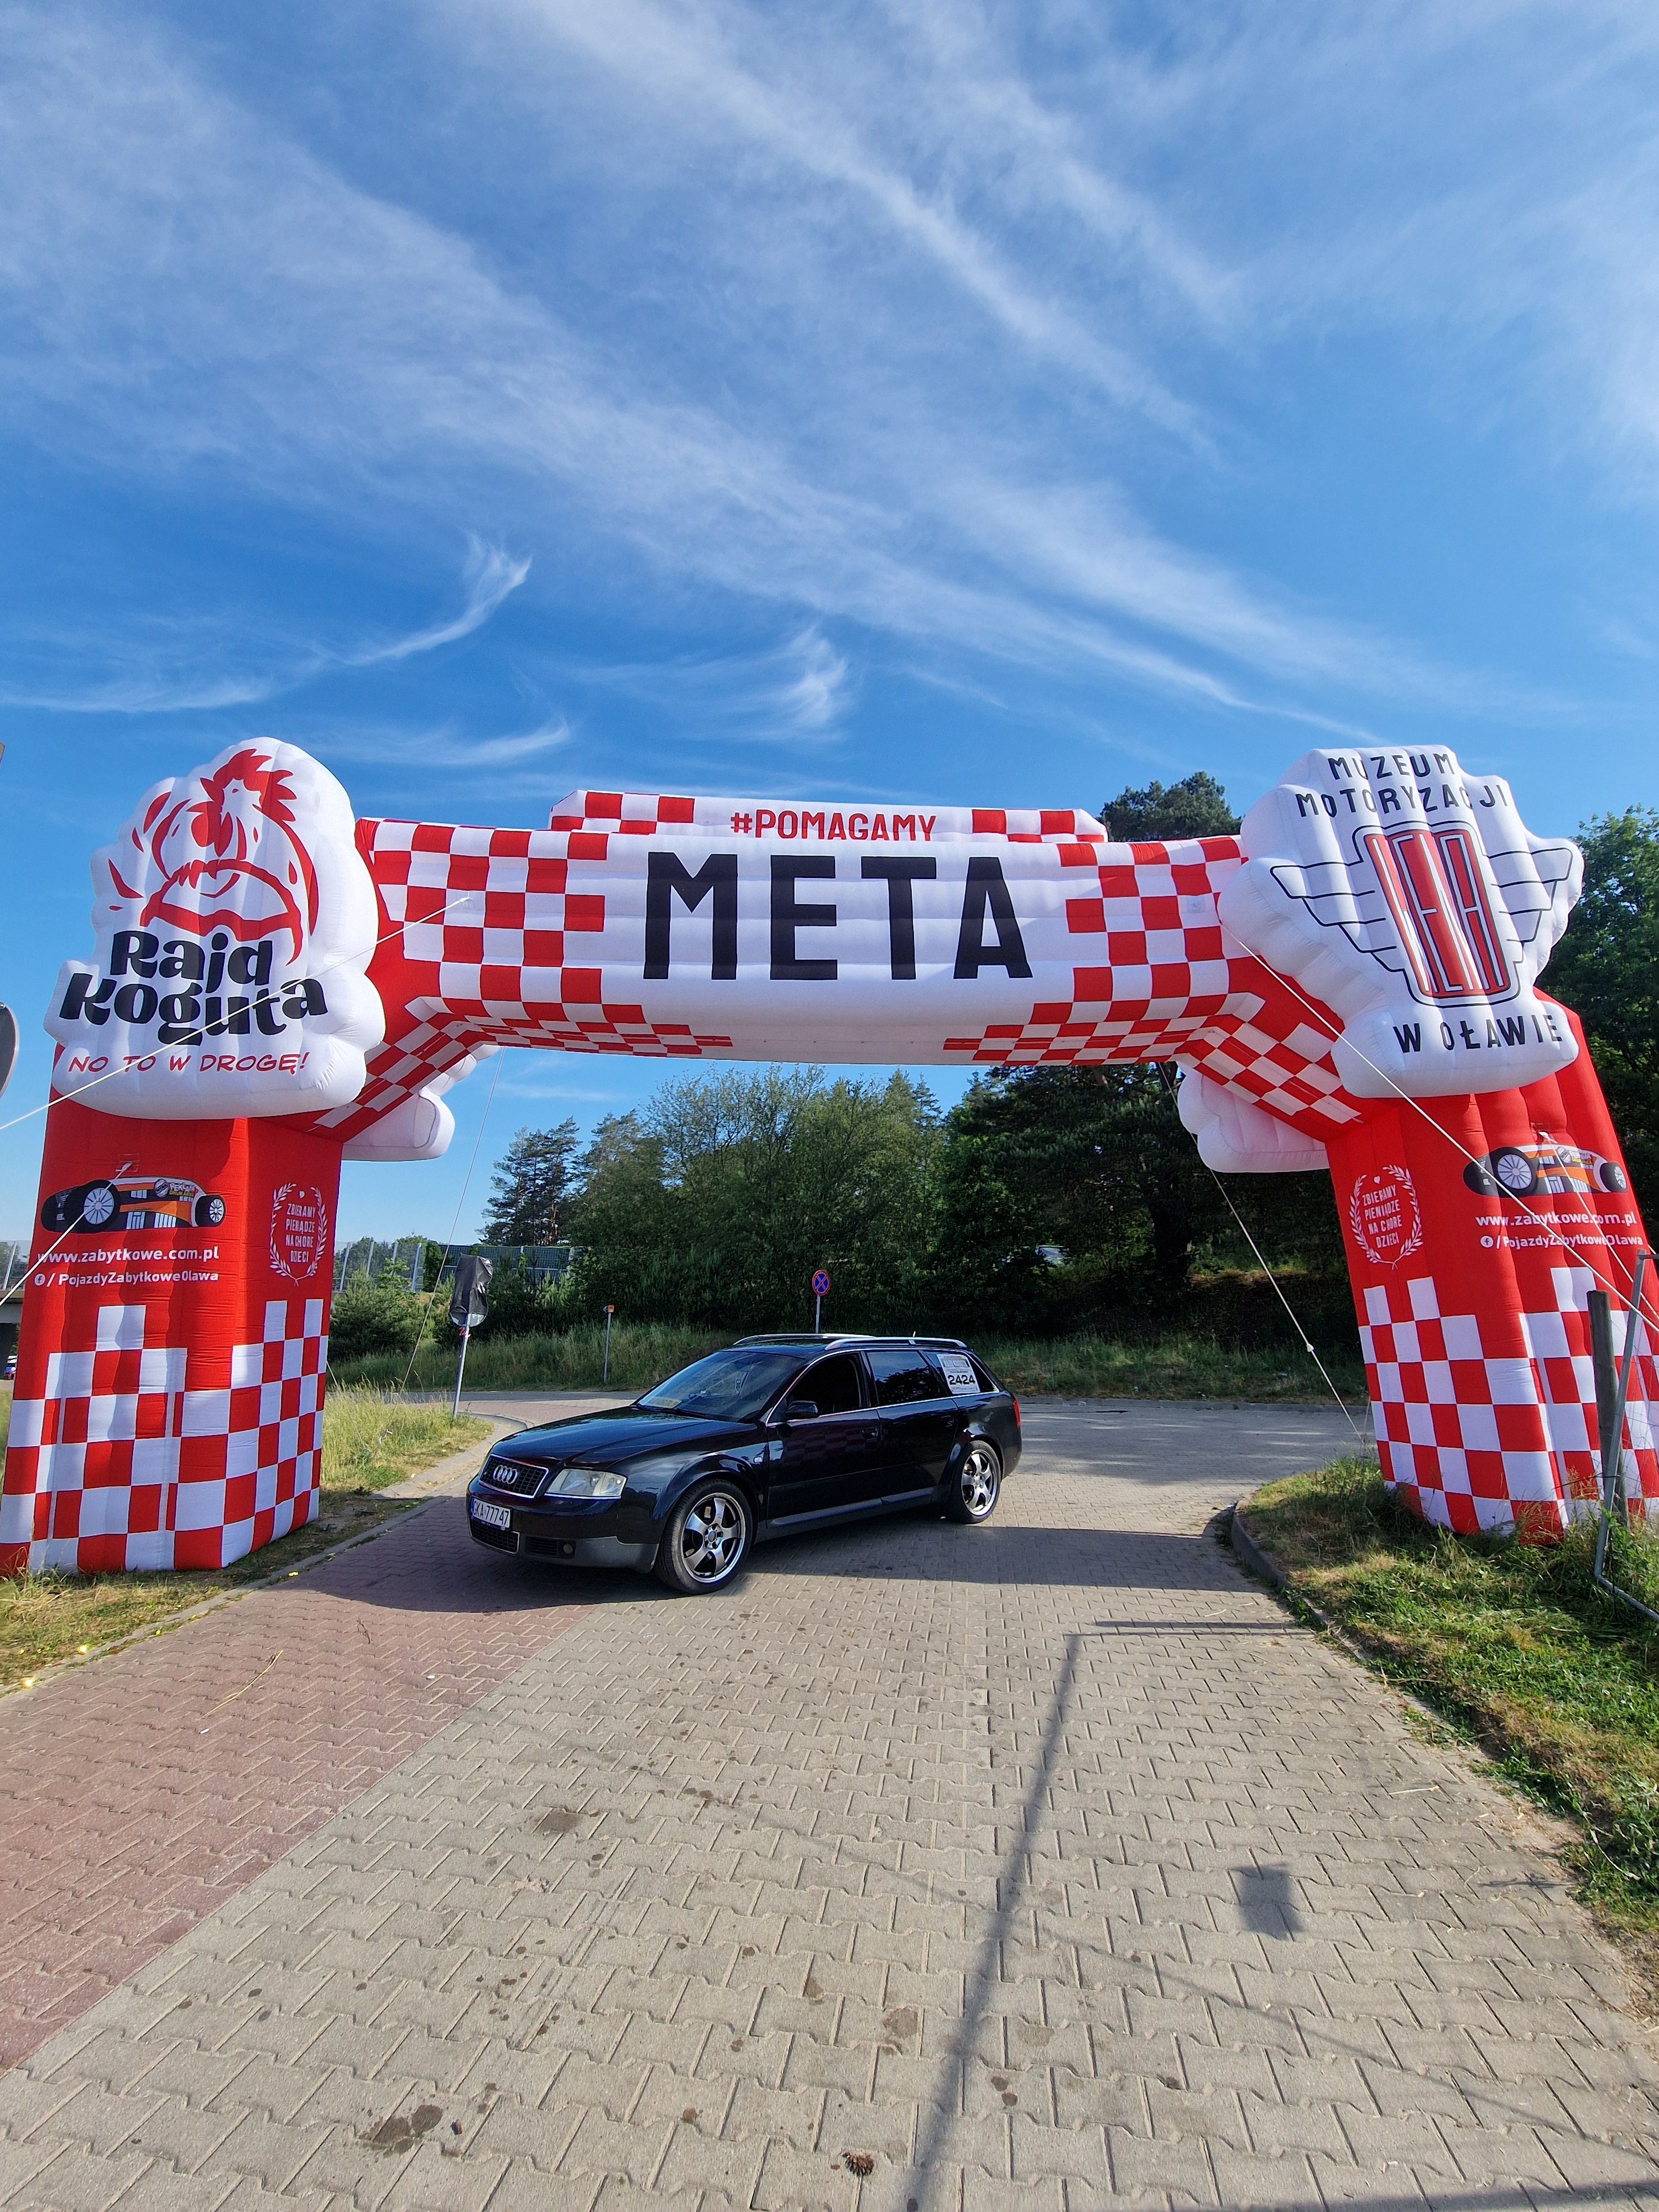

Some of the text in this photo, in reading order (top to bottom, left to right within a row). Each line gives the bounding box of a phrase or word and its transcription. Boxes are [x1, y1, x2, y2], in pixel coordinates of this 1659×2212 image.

[1328, 753, 1455, 780] MUZEUM
[1295, 784, 1509, 818] MOTORYZACJI
[730, 809, 936, 841] #POMAGAMY
[643, 852, 1032, 980] META
[110, 930, 273, 993] Rajd
[59, 973, 328, 1046] Koguta
[1392, 1014, 1563, 1053] W OŁAWIE
[68, 1052, 310, 1074] NO TO W DROGĘ!
[1362, 1184, 1396, 1206] ZBIERAMY
[286, 1203, 316, 1218] ZBIERAMY
[1364, 1199, 1400, 1220] PIENIĄDZE
[1475, 1211, 1637, 1227] www.zabytkowe.com.pl
[1368, 1215, 1402, 1235] NA CHORE
[285, 1234, 314, 1248] NA CHORE
[1376, 1232, 1399, 1248] DZIECI
[37, 1246, 219, 1264] www.zabytkowe.com.pl
[290, 1250, 309, 1262] DZIECI
[948, 1374, 975, 1385] 2424
[473, 1501, 509, 1526] GKA 77747
